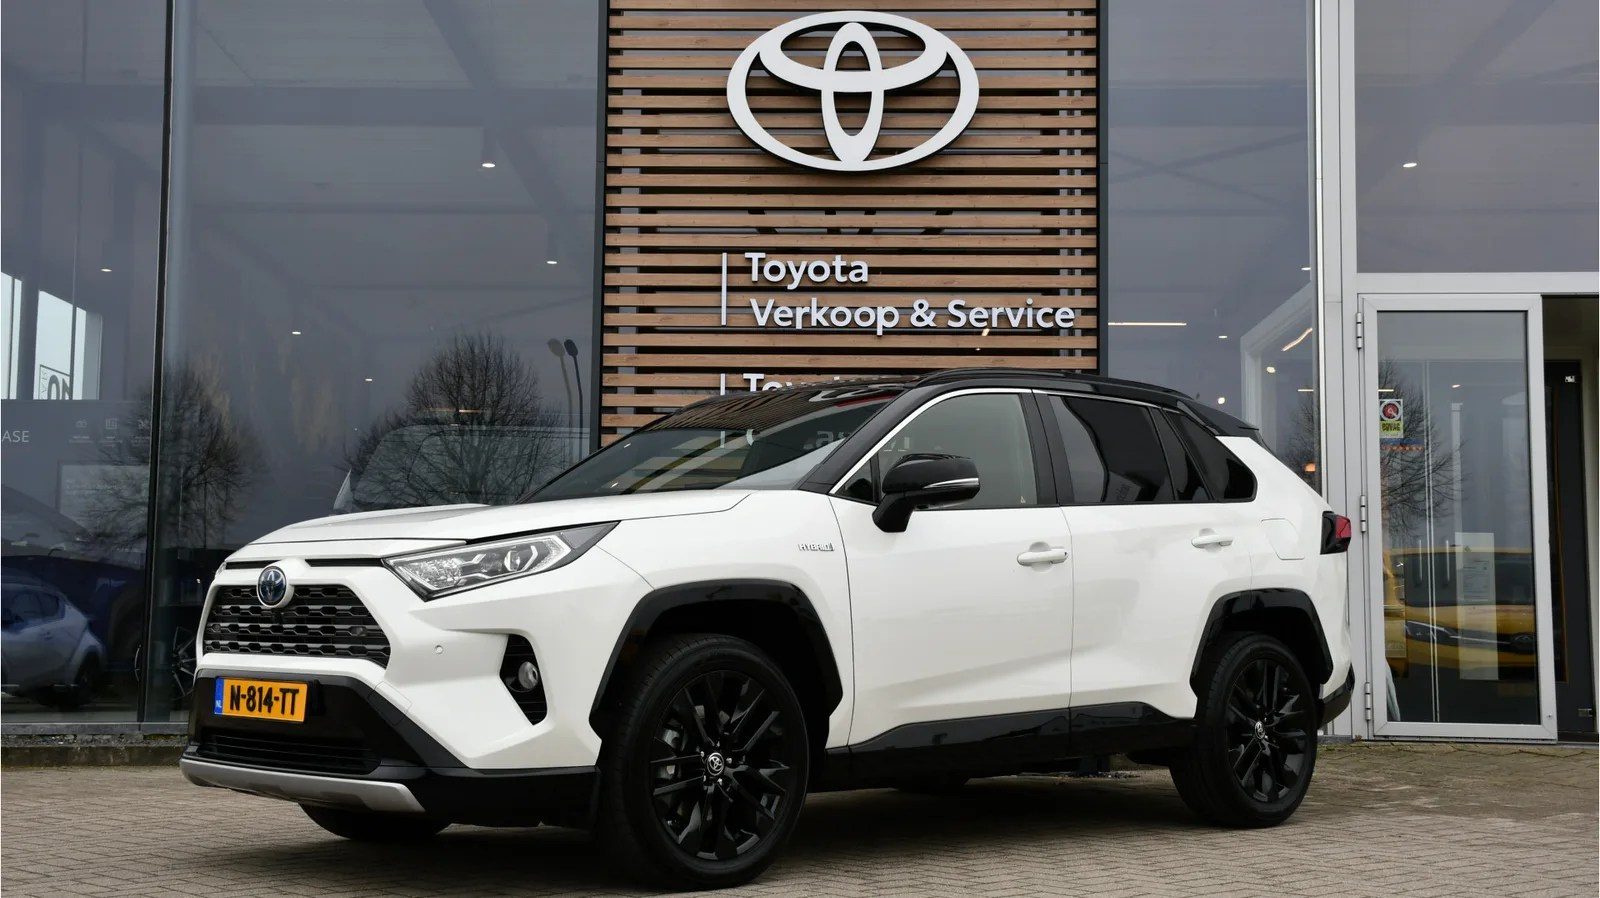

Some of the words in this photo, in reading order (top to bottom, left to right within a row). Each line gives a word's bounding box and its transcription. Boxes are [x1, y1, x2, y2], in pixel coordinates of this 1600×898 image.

[744, 251, 869, 290] Toyota
[749, 297, 900, 336] Verkoop
[909, 299, 937, 327] &
[947, 298, 1075, 328] Service
[215, 699, 222, 708] NL
[229, 684, 300, 716] N-814-TT
